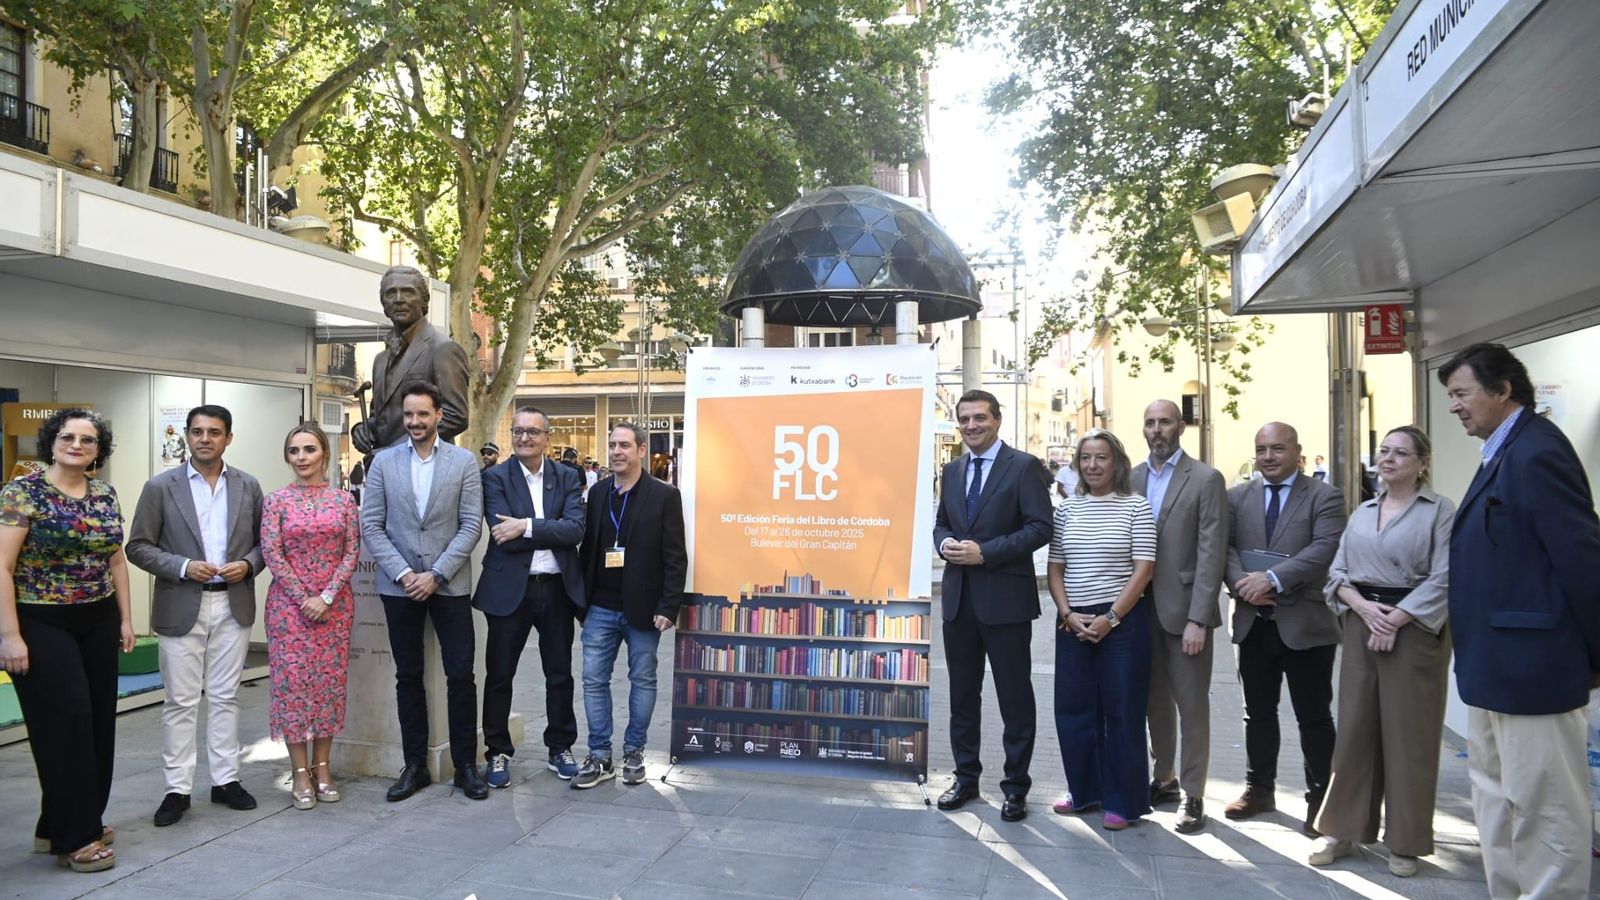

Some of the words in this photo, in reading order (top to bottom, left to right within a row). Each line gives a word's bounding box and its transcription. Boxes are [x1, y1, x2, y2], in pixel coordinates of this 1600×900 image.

[1407, 34, 1427, 81] RED
[799, 376, 836, 385] kutxabank
[774, 424, 840, 473] 50
[773, 469, 839, 501] FLC
[737, 513, 770, 523] Edición
[772, 514, 795, 524] Feria
[796, 514, 810, 525] del
[811, 515, 836, 526] Libro
[837, 516, 849, 525] de
[850, 515, 891, 527] Córdoba
[744, 525, 759, 536] Del
[760, 526, 769, 536] 17
[769, 526, 778, 537] al
[792, 527, 804, 537] de
[804, 528, 840, 538] octubre
[841, 528, 865, 538] 2025
[751, 537, 783, 548] Bulevar
[784, 538, 799, 549] del
[800, 539, 821, 550] Gran
[822, 540, 857, 551] Capitán
[780, 741, 799, 749] PLAN
